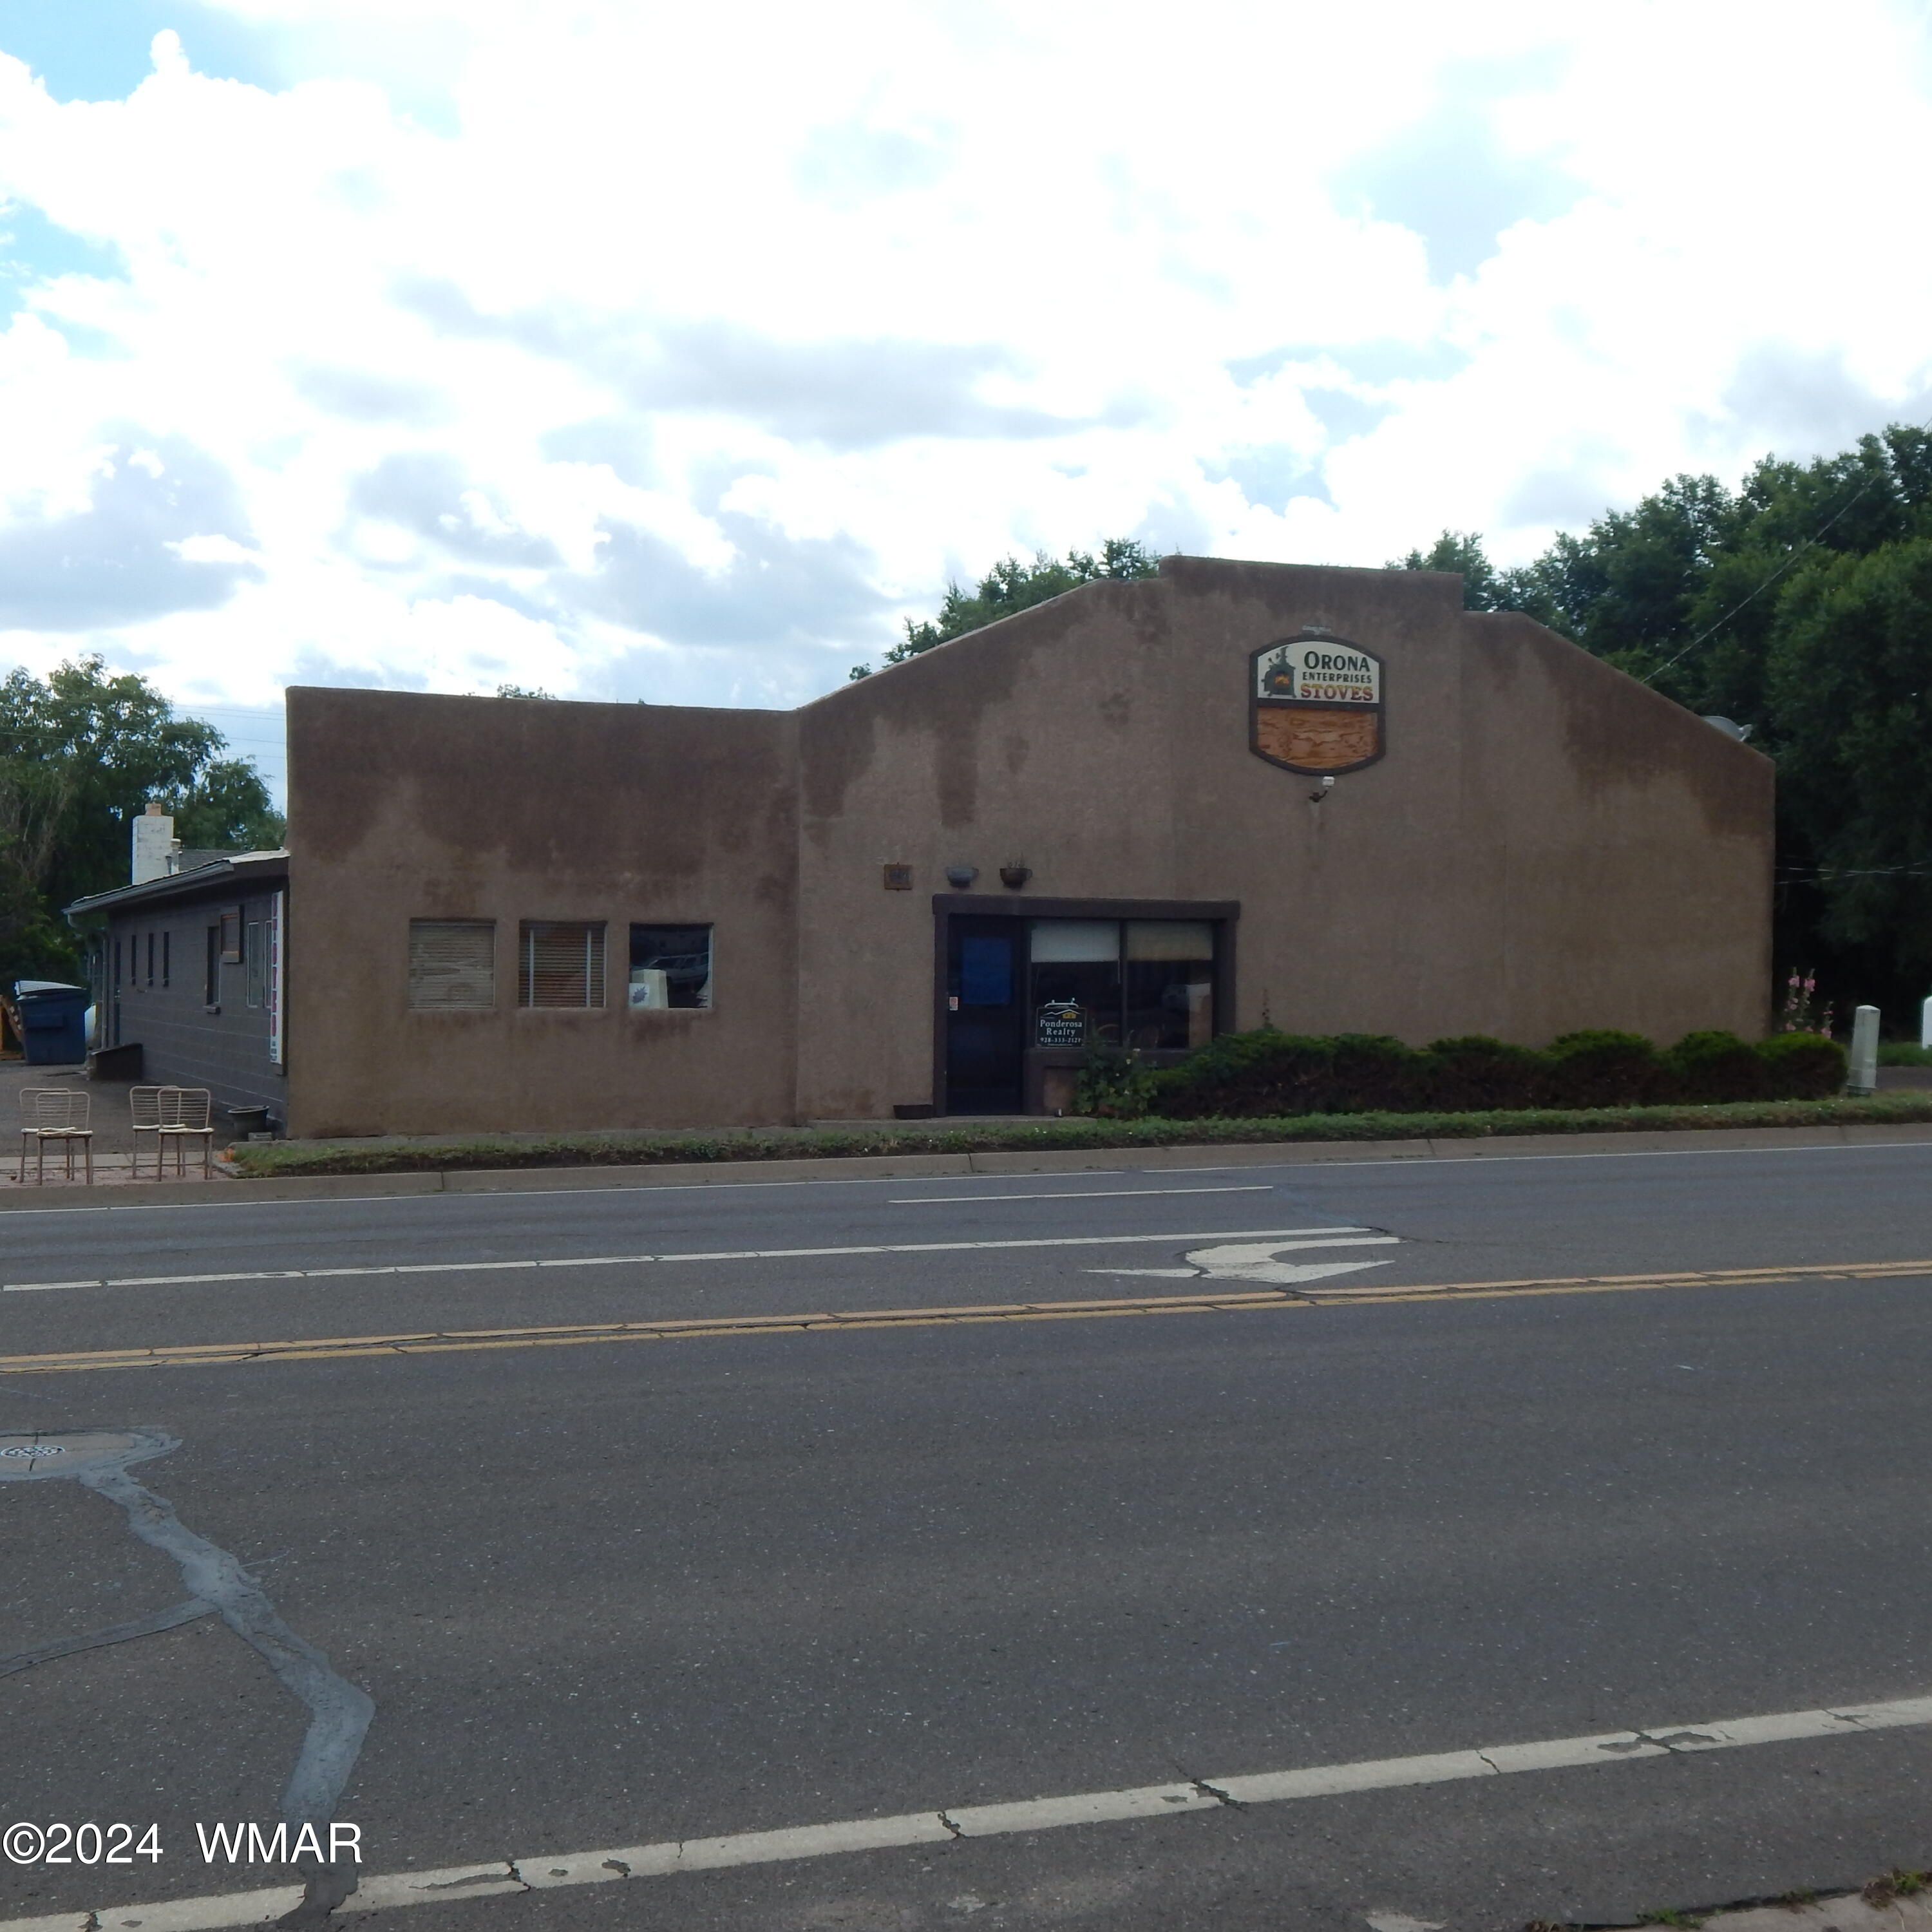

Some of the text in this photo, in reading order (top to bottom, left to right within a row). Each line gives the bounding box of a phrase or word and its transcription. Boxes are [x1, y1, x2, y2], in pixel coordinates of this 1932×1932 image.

[1304, 651, 1370, 672] ORONA
[1302, 672, 1372, 683] ENTERPRISES
[1301, 683, 1373, 701] STOVES
[1046, 1028, 1075, 1037] Realty
